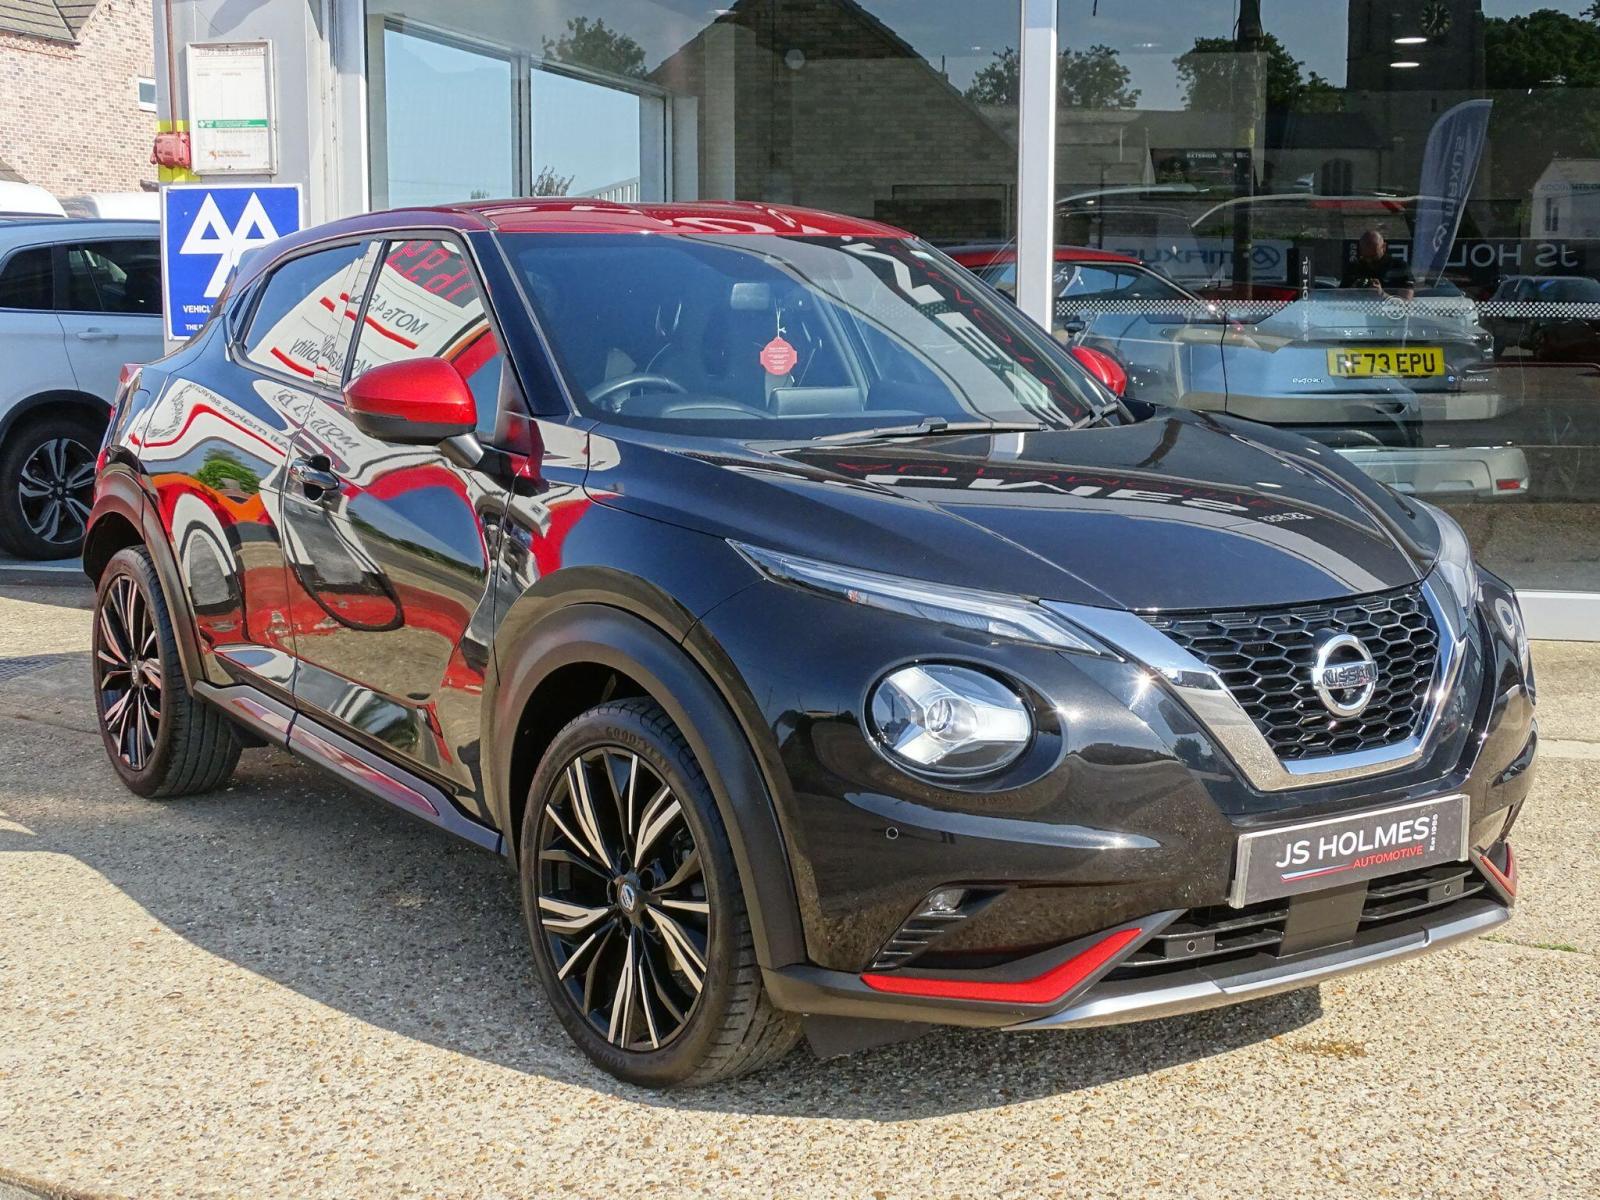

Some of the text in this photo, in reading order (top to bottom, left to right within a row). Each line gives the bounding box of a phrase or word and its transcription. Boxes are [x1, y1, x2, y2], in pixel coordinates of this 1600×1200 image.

[183, 304, 214, 314] VEHICL
[1336, 353, 1436, 375] RF73 EPU
[1275, 816, 1432, 868] JS HOLMES
[1353, 845, 1424, 869] AUTOMOTIVE
